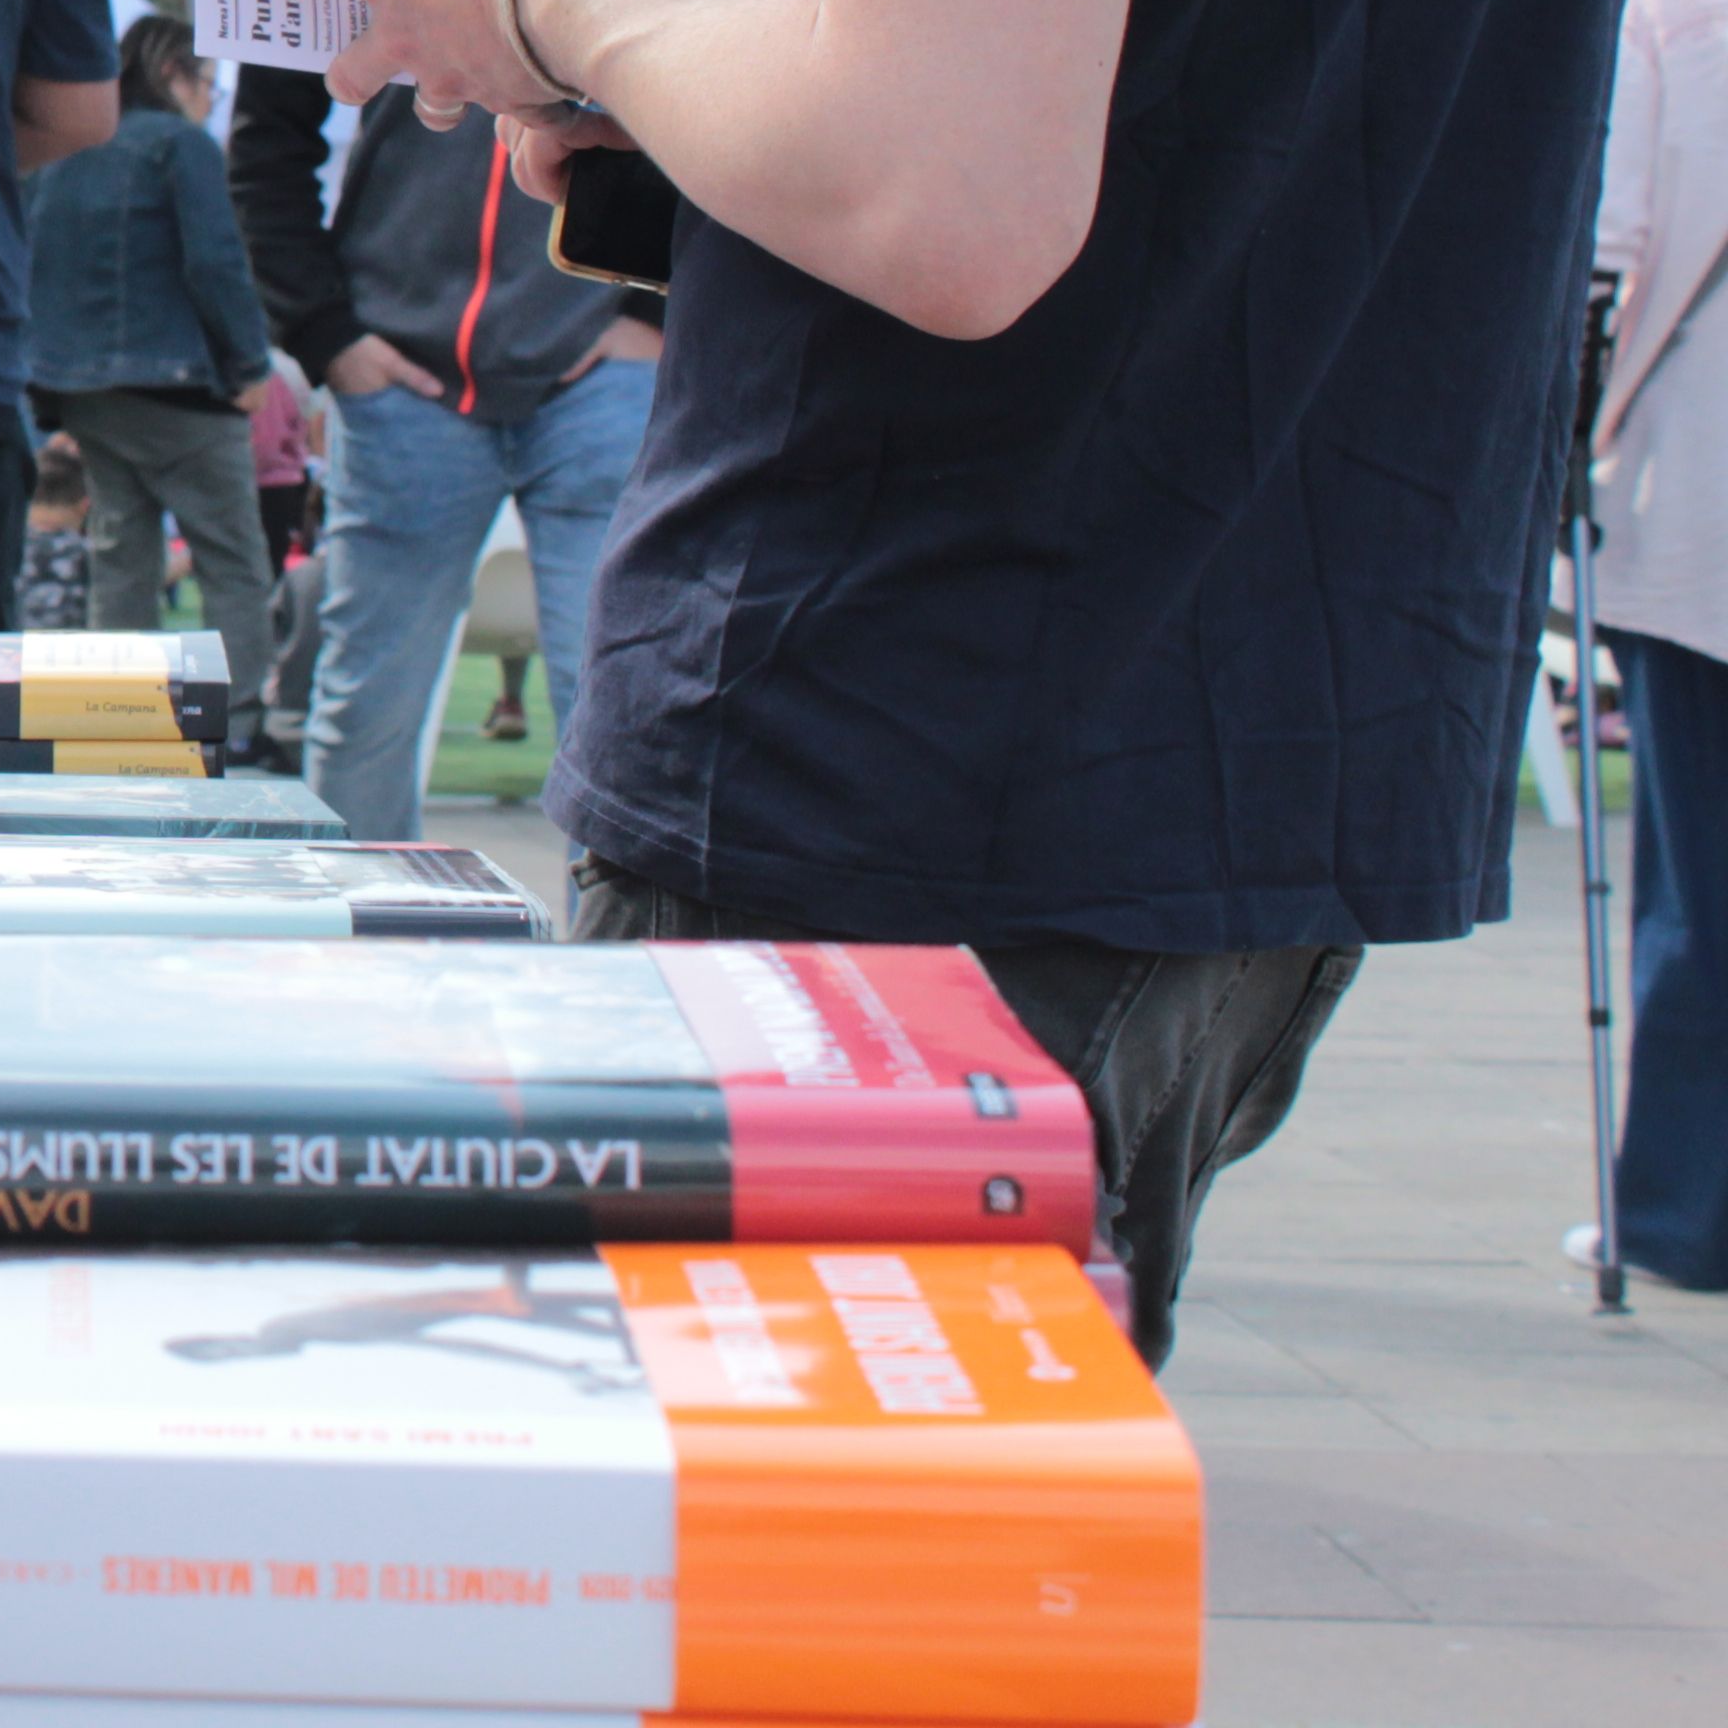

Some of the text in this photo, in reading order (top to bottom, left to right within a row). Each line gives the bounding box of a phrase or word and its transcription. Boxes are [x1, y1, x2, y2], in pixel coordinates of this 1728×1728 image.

[217, 8, 229, 39] Nerea
[84, 700, 158, 718] La Campana
[169, 1132, 255, 1187] LES
[271, 1133, 338, 1188] DE
[356, 1134, 561, 1190] CIUTAT
[565, 1137, 642, 1191] LA
[99, 1555, 254, 1600] MANERES
[264, 1558, 317, 1603] MIL
[324, 1559, 372, 1604] DE
[376, 1559, 551, 1608] PROMETEU
